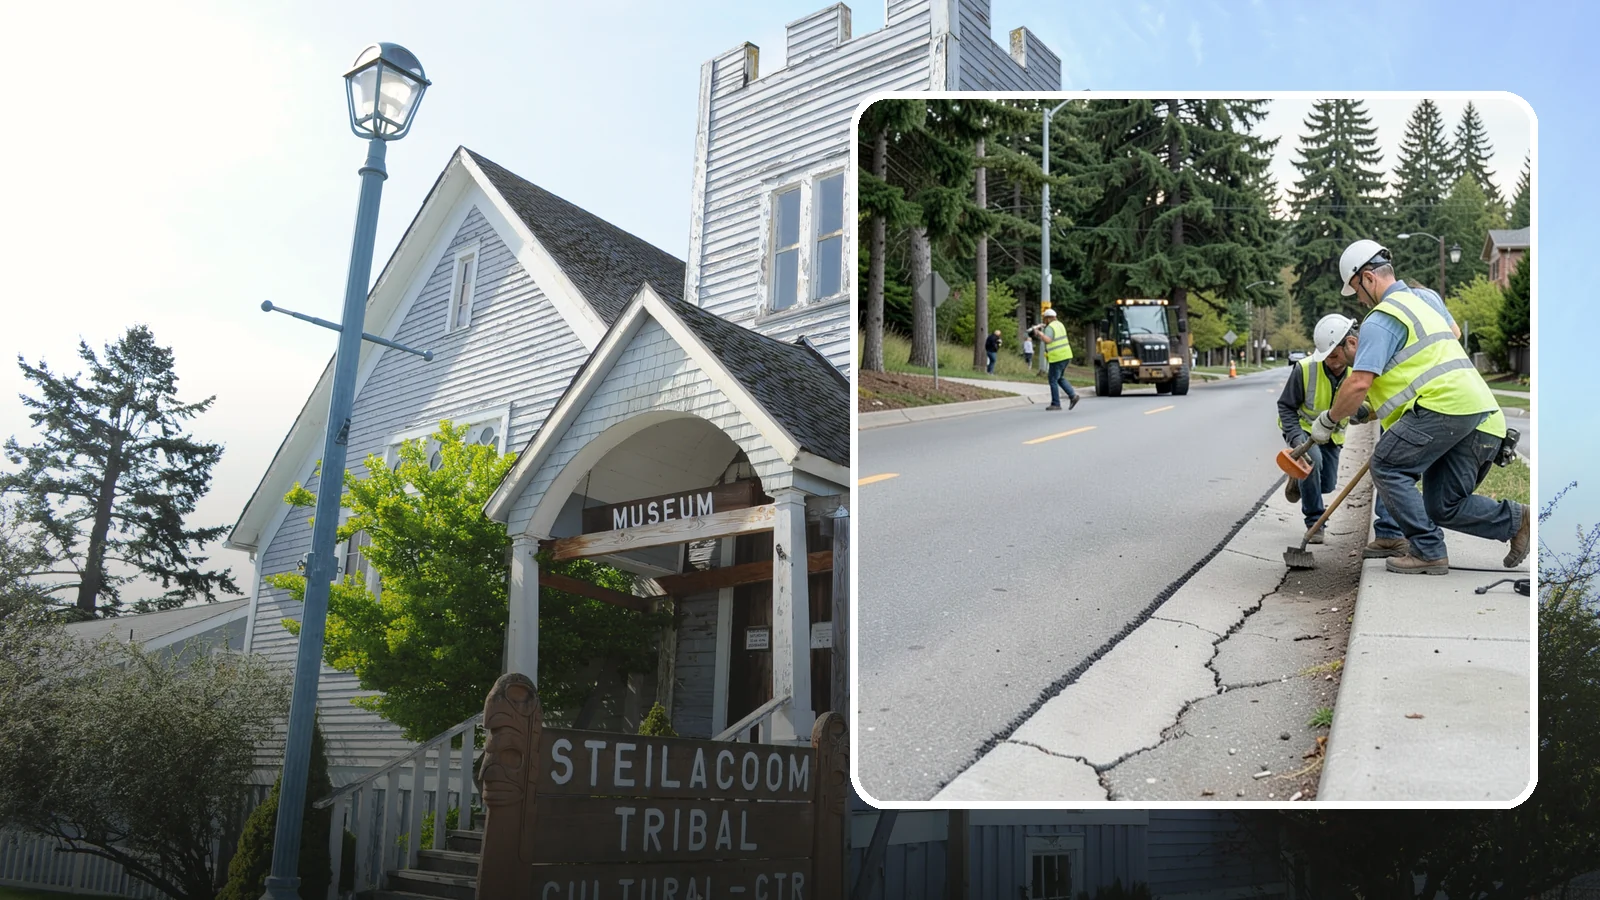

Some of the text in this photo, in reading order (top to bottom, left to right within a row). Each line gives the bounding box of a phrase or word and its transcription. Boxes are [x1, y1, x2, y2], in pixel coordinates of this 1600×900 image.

[612, 491, 714, 531] MUSEUM
[550, 738, 810, 792] STEILACOOM
[614, 806, 758, 851] TRIBAL
